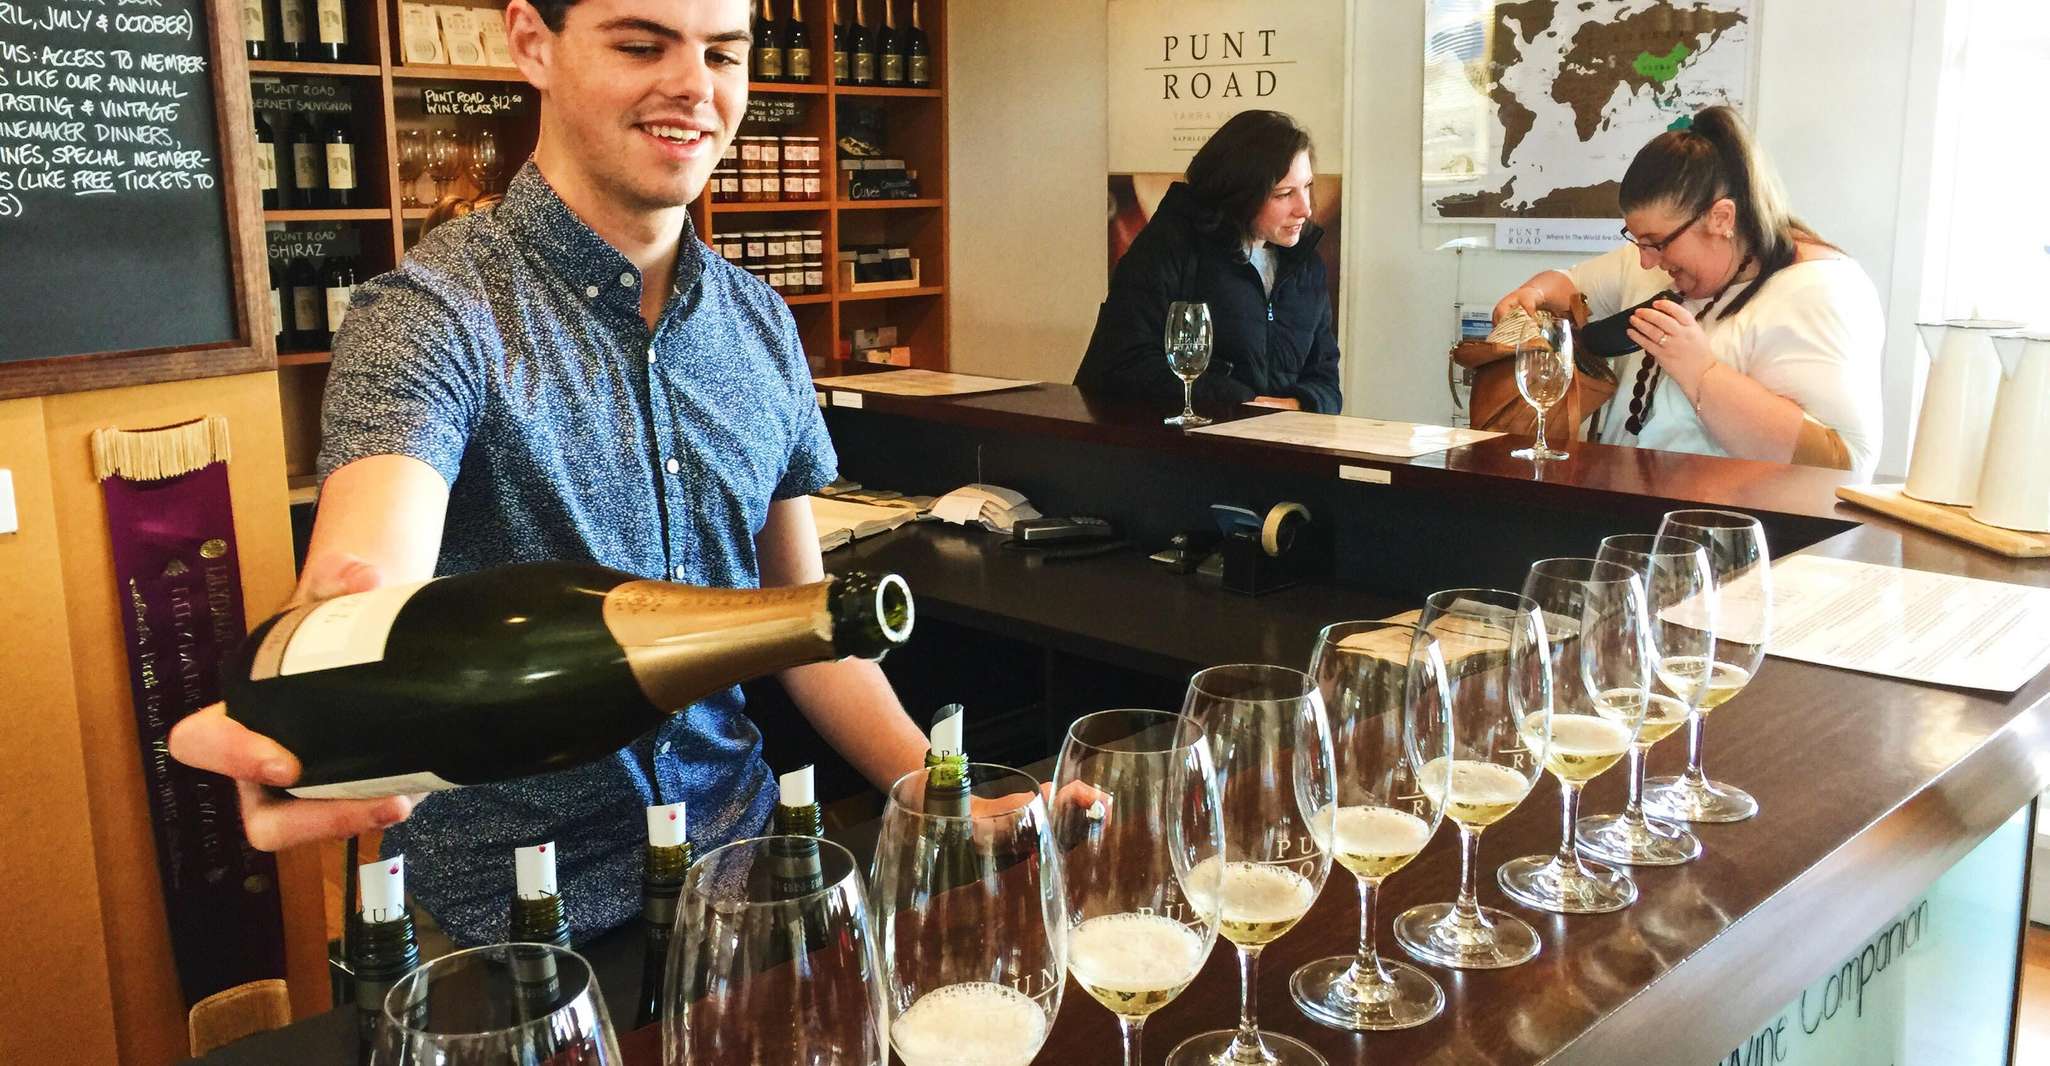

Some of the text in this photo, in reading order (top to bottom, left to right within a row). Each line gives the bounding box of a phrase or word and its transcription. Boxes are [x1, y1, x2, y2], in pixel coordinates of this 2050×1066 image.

[0, 2, 193, 40] RIL, JULY & OCTOBER)
[1163, 30, 1276, 61] PUNT
[41, 46, 106, 68] ACCESS
[110, 50, 133, 69] TO
[140, 53, 208, 73] MEMBER-
[16, 69, 59, 88] LIKE
[65, 74, 102, 92] OUR
[107, 75, 188, 98] ANNUAL
[264, 83, 336, 97] PUNT ROAD
[424, 89, 485, 104] PUNT ROAD
[1163, 70, 1277, 99] ROAD
[0, 93, 181, 121] TASTING & VINTAGE
[253, 99, 295, 111] ERNET
[427, 103, 493, 115] WINE GLASS
[0, 120, 182, 149] INEMAKER DINNERS,
[0, 144, 211, 171] INES, SPECIAL MEMBER-
[18, 167, 66, 191] (LIKE
[71, 174, 115, 190] FREE
[118, 170, 191, 190] TICKETS
[193, 174, 214, 189] TO
[273, 231, 336, 241] PUNT ROAD
[1508, 228, 1541, 236] PUNT
[1508, 237, 1541, 245] ROAD
[268, 243, 327, 259] SHIRAZ
[1012, 961, 1057, 996] UN
[1801, 899, 1928, 1034] Companion
